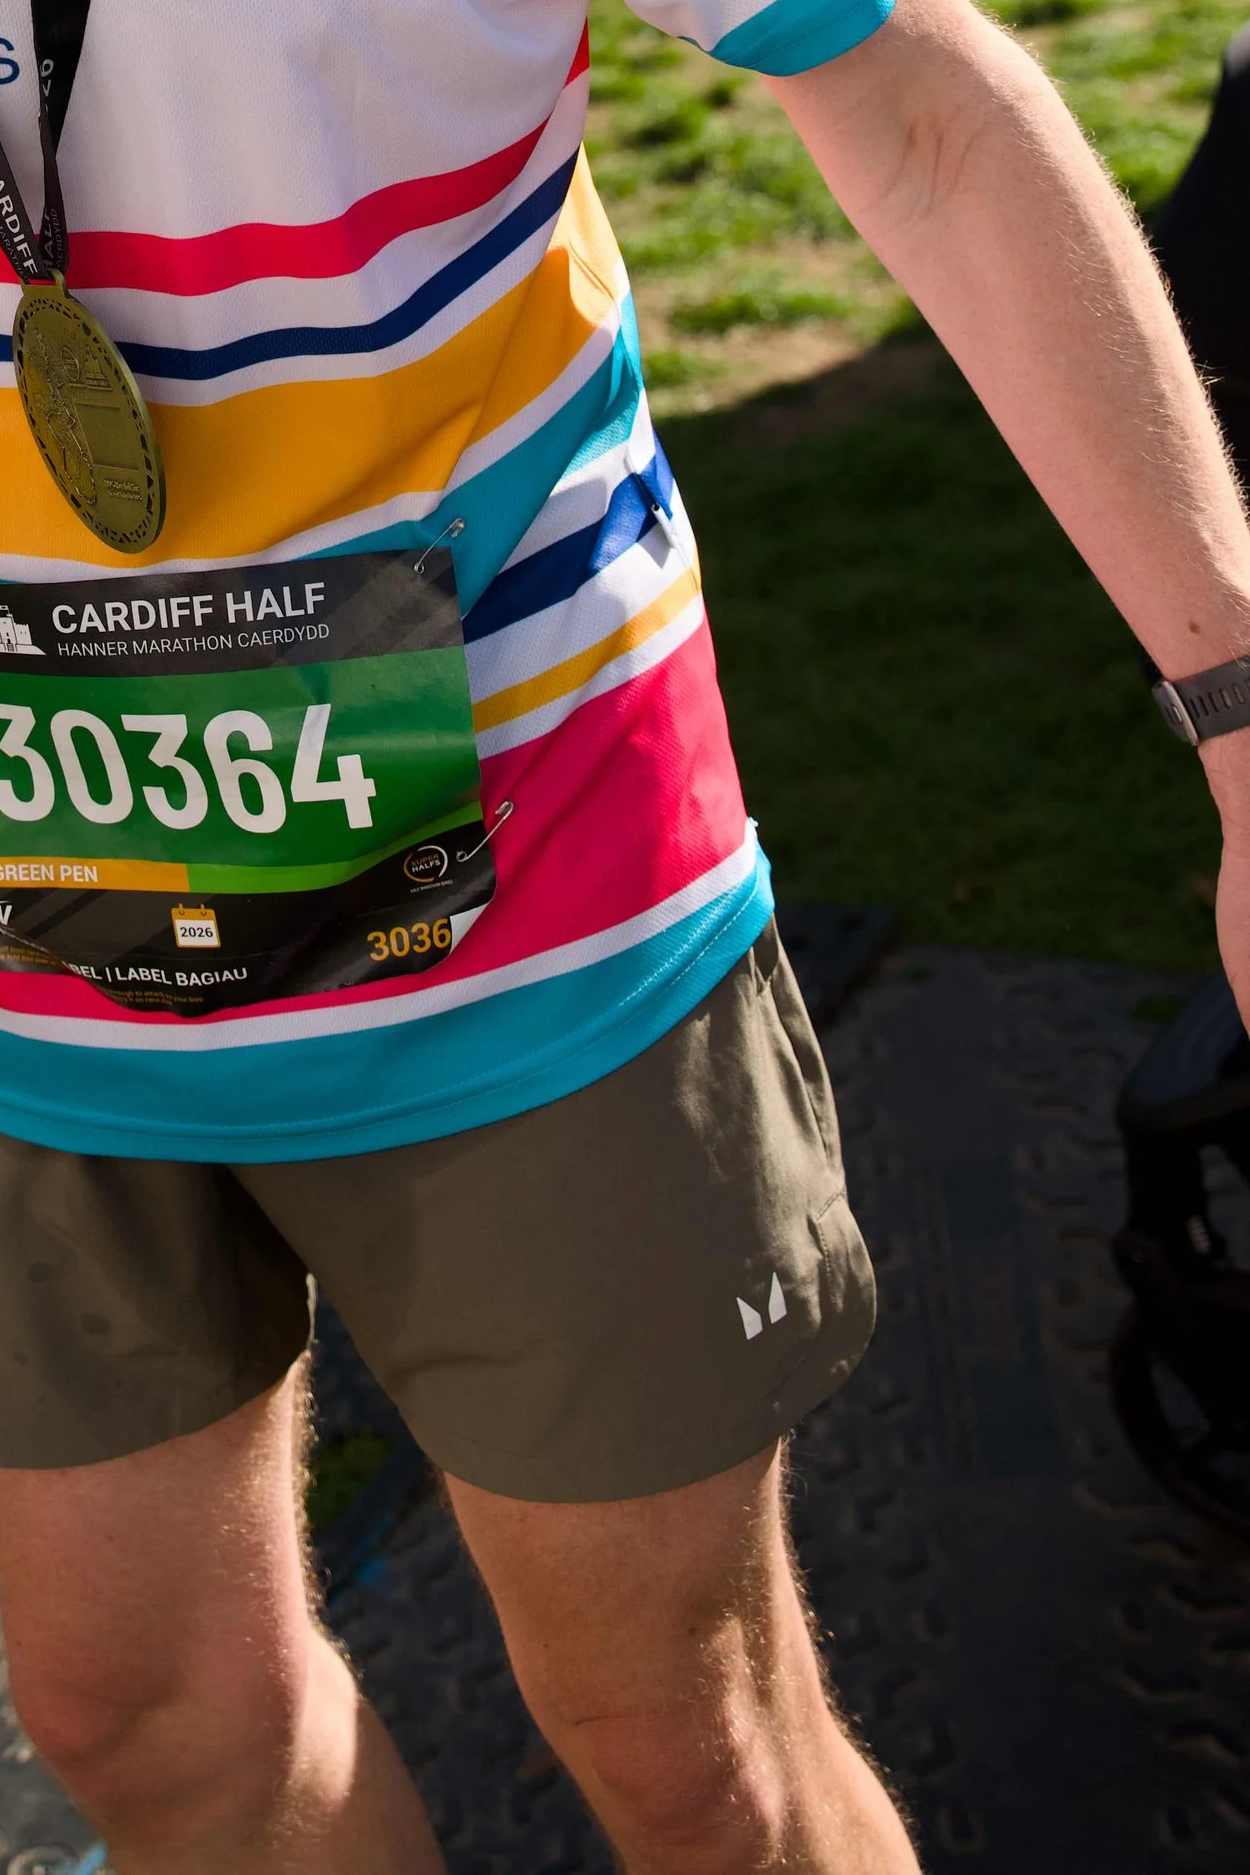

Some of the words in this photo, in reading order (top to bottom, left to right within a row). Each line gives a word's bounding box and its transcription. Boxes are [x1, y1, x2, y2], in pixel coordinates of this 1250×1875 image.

[51, 595, 213, 634] CARDIFF
[225, 582, 325, 624] HALF
[58, 641, 128, 657] HANNER
[132, 634, 233, 655] MARATHON
[237, 624, 330, 649] CAERDYDD
[410, 853, 440, 867] SUPER
[412, 859, 441, 873] HALFS
[60, 865, 99, 883] PEN
[180, 927, 214, 938] 2026
[366, 918, 451, 962] 3036
[114, 967, 172, 985] LABEL
[175, 967, 248, 987] BAGIAU
